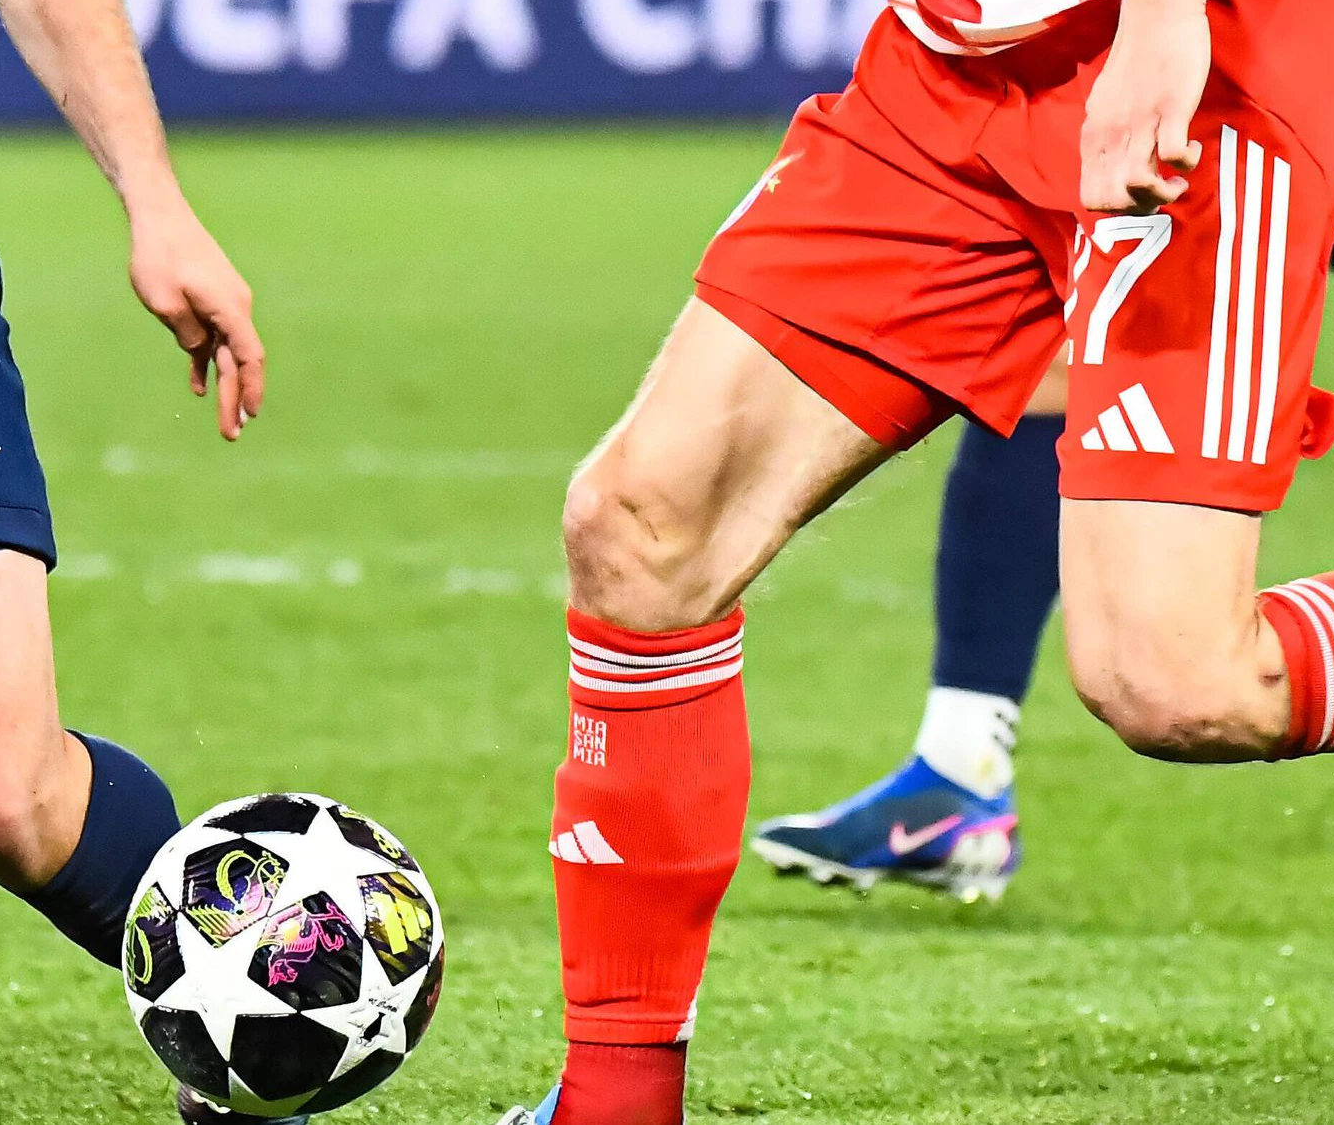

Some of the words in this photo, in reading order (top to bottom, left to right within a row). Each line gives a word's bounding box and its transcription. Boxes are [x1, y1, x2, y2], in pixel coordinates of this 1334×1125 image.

[573, 712, 607, 737] MIA
[573, 730, 607, 751] SAN
[573, 743, 607, 767] MIA
